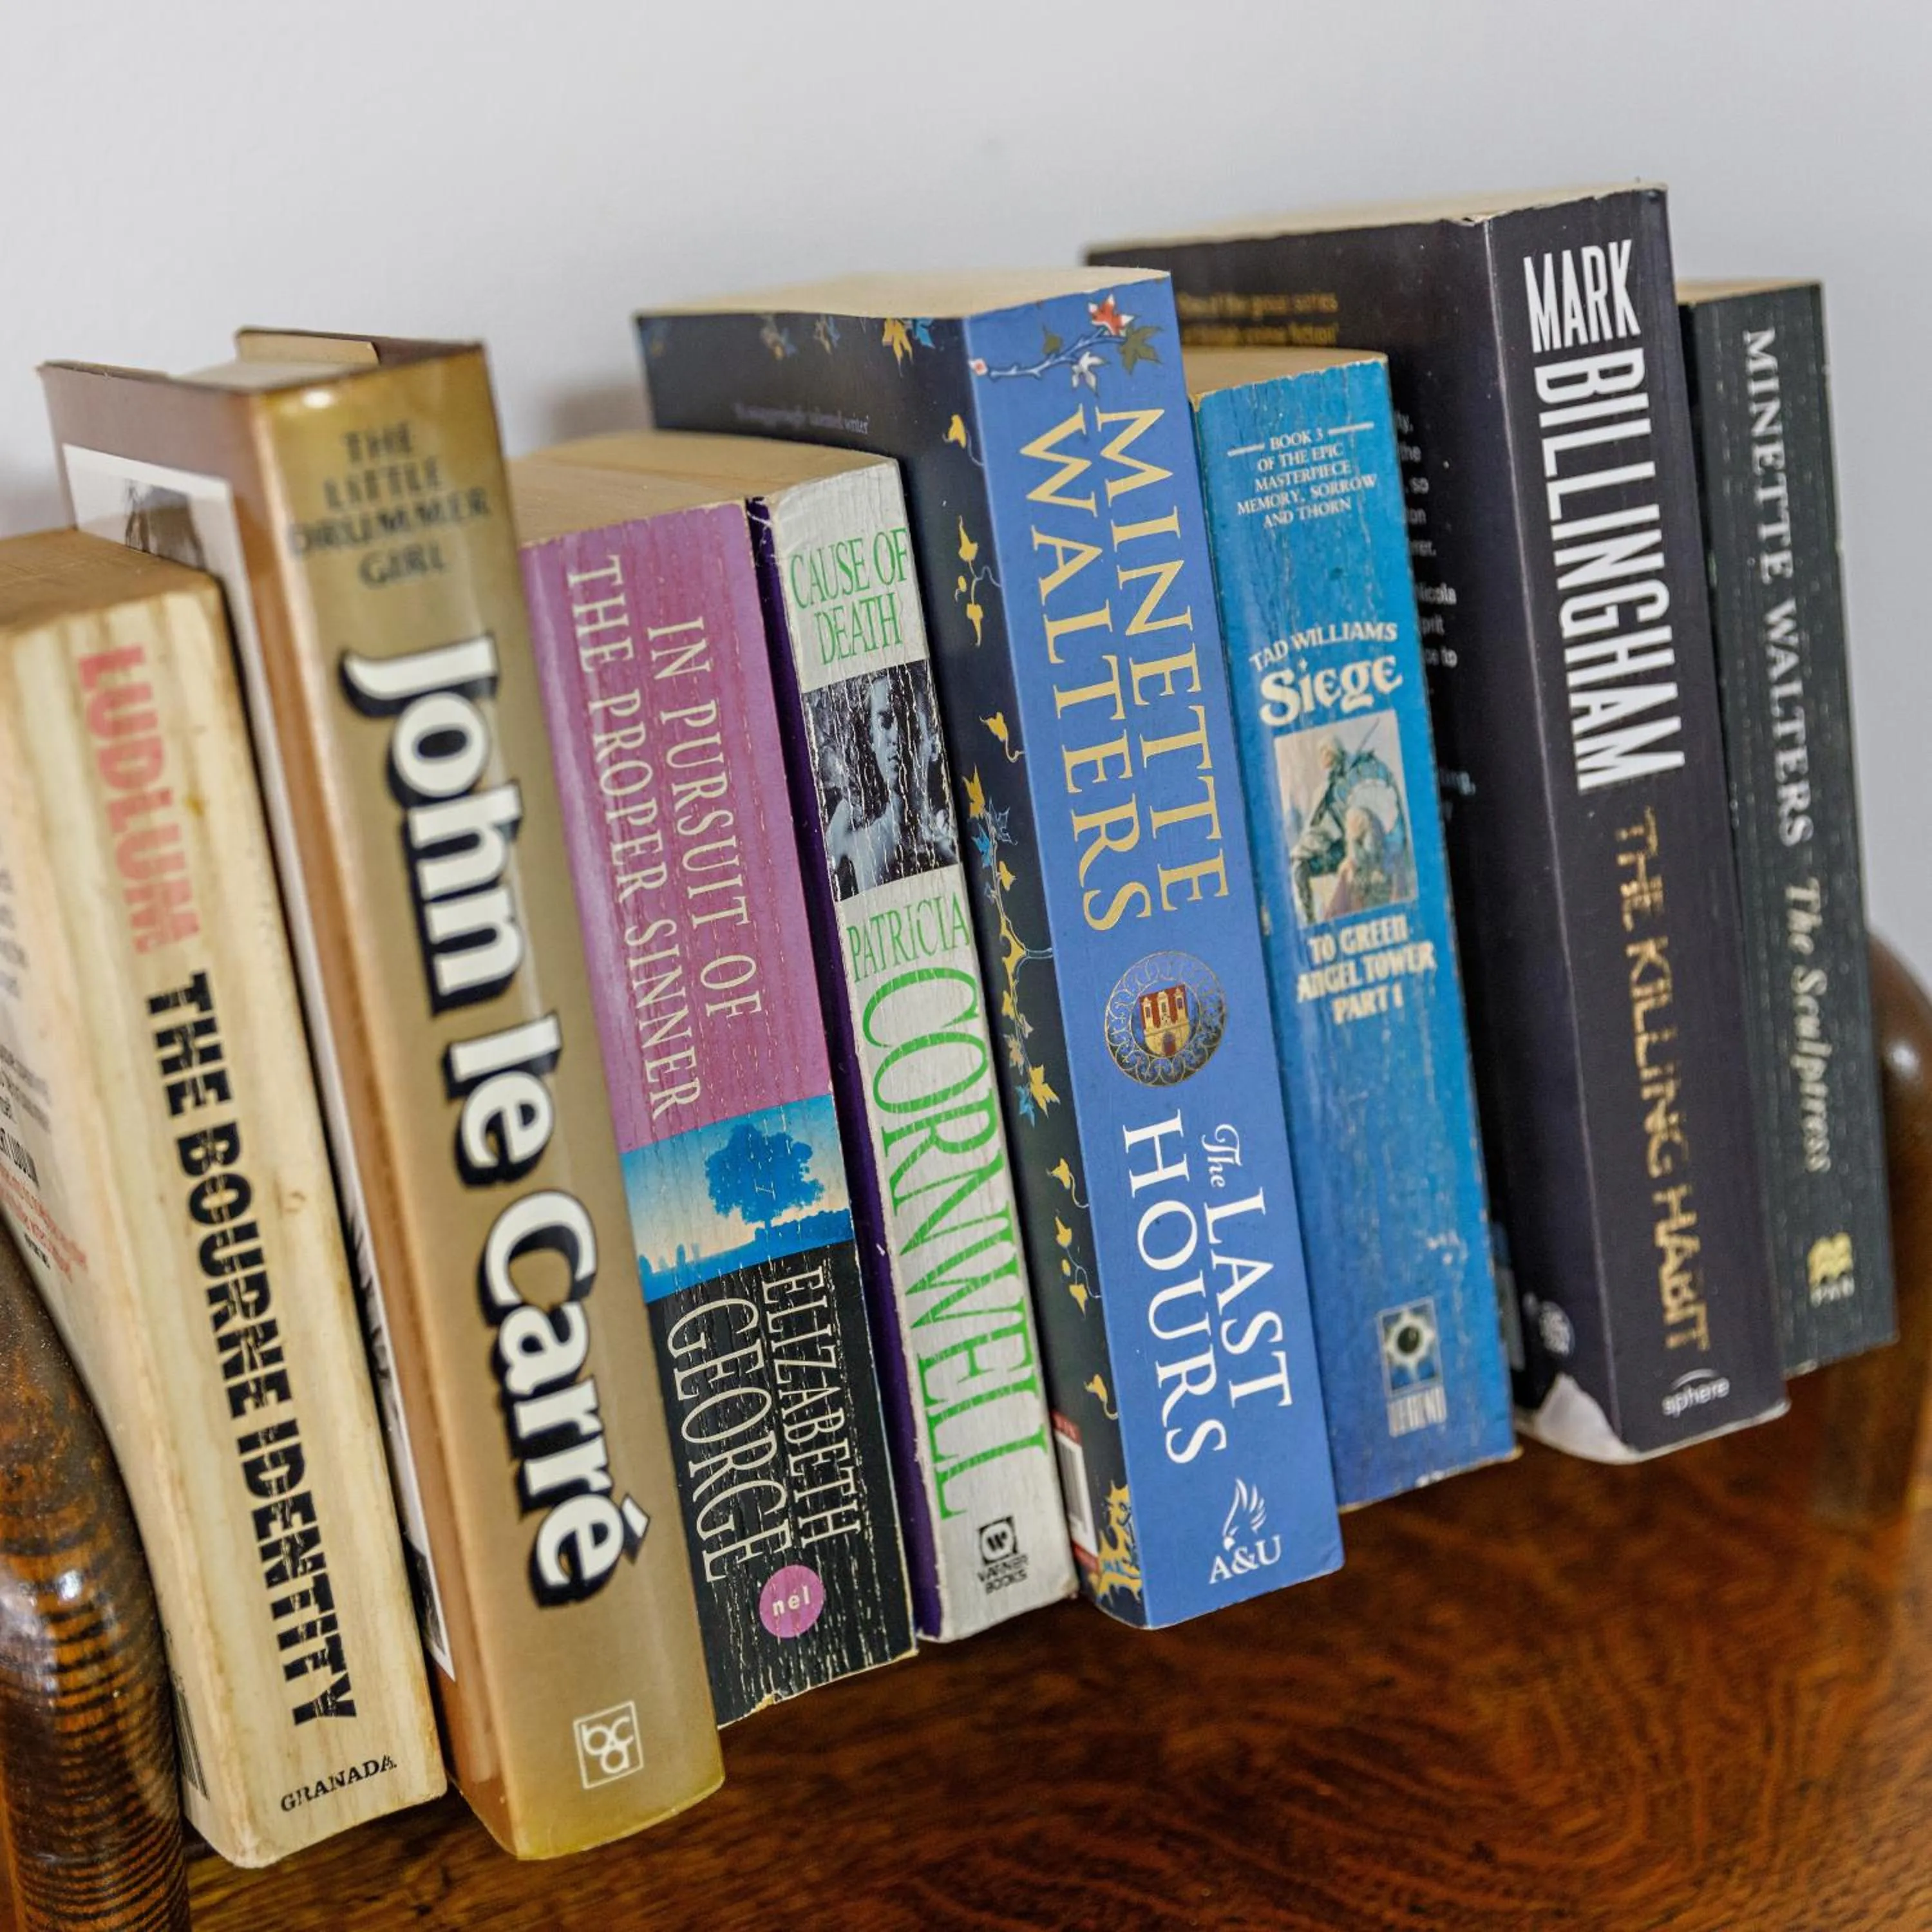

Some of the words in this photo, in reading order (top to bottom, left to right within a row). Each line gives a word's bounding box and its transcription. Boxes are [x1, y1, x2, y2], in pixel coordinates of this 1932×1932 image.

[1524, 240, 1641, 353] MARK
[323, 456, 443, 513] LITTLE
[345, 422, 413, 465] THE
[1255, 459, 1351, 493] MASTERPIECE
[1257, 456, 1275, 472] OF
[1279, 450, 1309, 468] THE
[1311, 442, 1343, 460] EPIC
[1269, 429, 1312, 451] BOOK
[1309, 473, 1378, 500] SORROW
[1742, 328, 1794, 585] MINETTE
[358, 540, 447, 591] GIRL
[789, 538, 869, 611] CAUSE
[873, 528, 908, 585] OF
[1263, 509, 1294, 529] AND
[1296, 496, 1351, 521] THORN
[1534, 346, 1685, 792] BILLINGHAM
[567, 554, 634, 672] THE
[647, 616, 712, 681] IN
[815, 592, 903, 665] DEATH
[1020, 403, 1151, 931] WALTERS
[1095, 408, 1229, 912] MINETTE
[1248, 639, 1289, 672] TAD
[1290, 621, 1398, 651] WILLIAMS
[1258, 654, 1404, 727] Siege
[1761, 597, 1815, 847] WALTERS
[77, 645, 202, 956] LUDLUM
[340, 632, 524, 1016] John
[587, 689, 669, 904] PROPER
[660, 699, 749, 929] PURSUIT
[1615, 805, 1665, 932] THE
[1785, 876, 1823, 956] The
[700, 954, 762, 1019] OF
[846, 893, 972, 982] PATRICIA
[1296, 959, 1363, 1004] ANGEL
[1361, 940, 1439, 983] TOWER
[1307, 933, 1337, 965] TO
[1339, 913, 1410, 956] GREEN
[146, 970, 234, 1117] THE
[625, 918, 701, 1122] SINNER
[1331, 984, 1390, 1025] PART
[1625, 935, 1690, 1179] KILLING
[442, 1011, 563, 1189] le
[1790, 965, 1833, 1174] Sculptress
[1202, 1123, 1242, 1188] The
[175, 1121, 294, 1420] BOURNE
[861, 968, 1050, 1521] CORNWELL
[1122, 1108, 1227, 1464] HOURS
[1204, 1186, 1293, 1408] LAST
[477, 1189, 650, 1607] Carré
[667, 1297, 793, 1584] GEORGE
[762, 1269, 863, 1549] ELIZABETH
[1662, 1377, 1730, 1418] sphere
[237, 1419, 357, 1726] IDENTITY
[772, 1584, 811, 1619] nel
[1208, 1535, 1282, 1585] A&U
